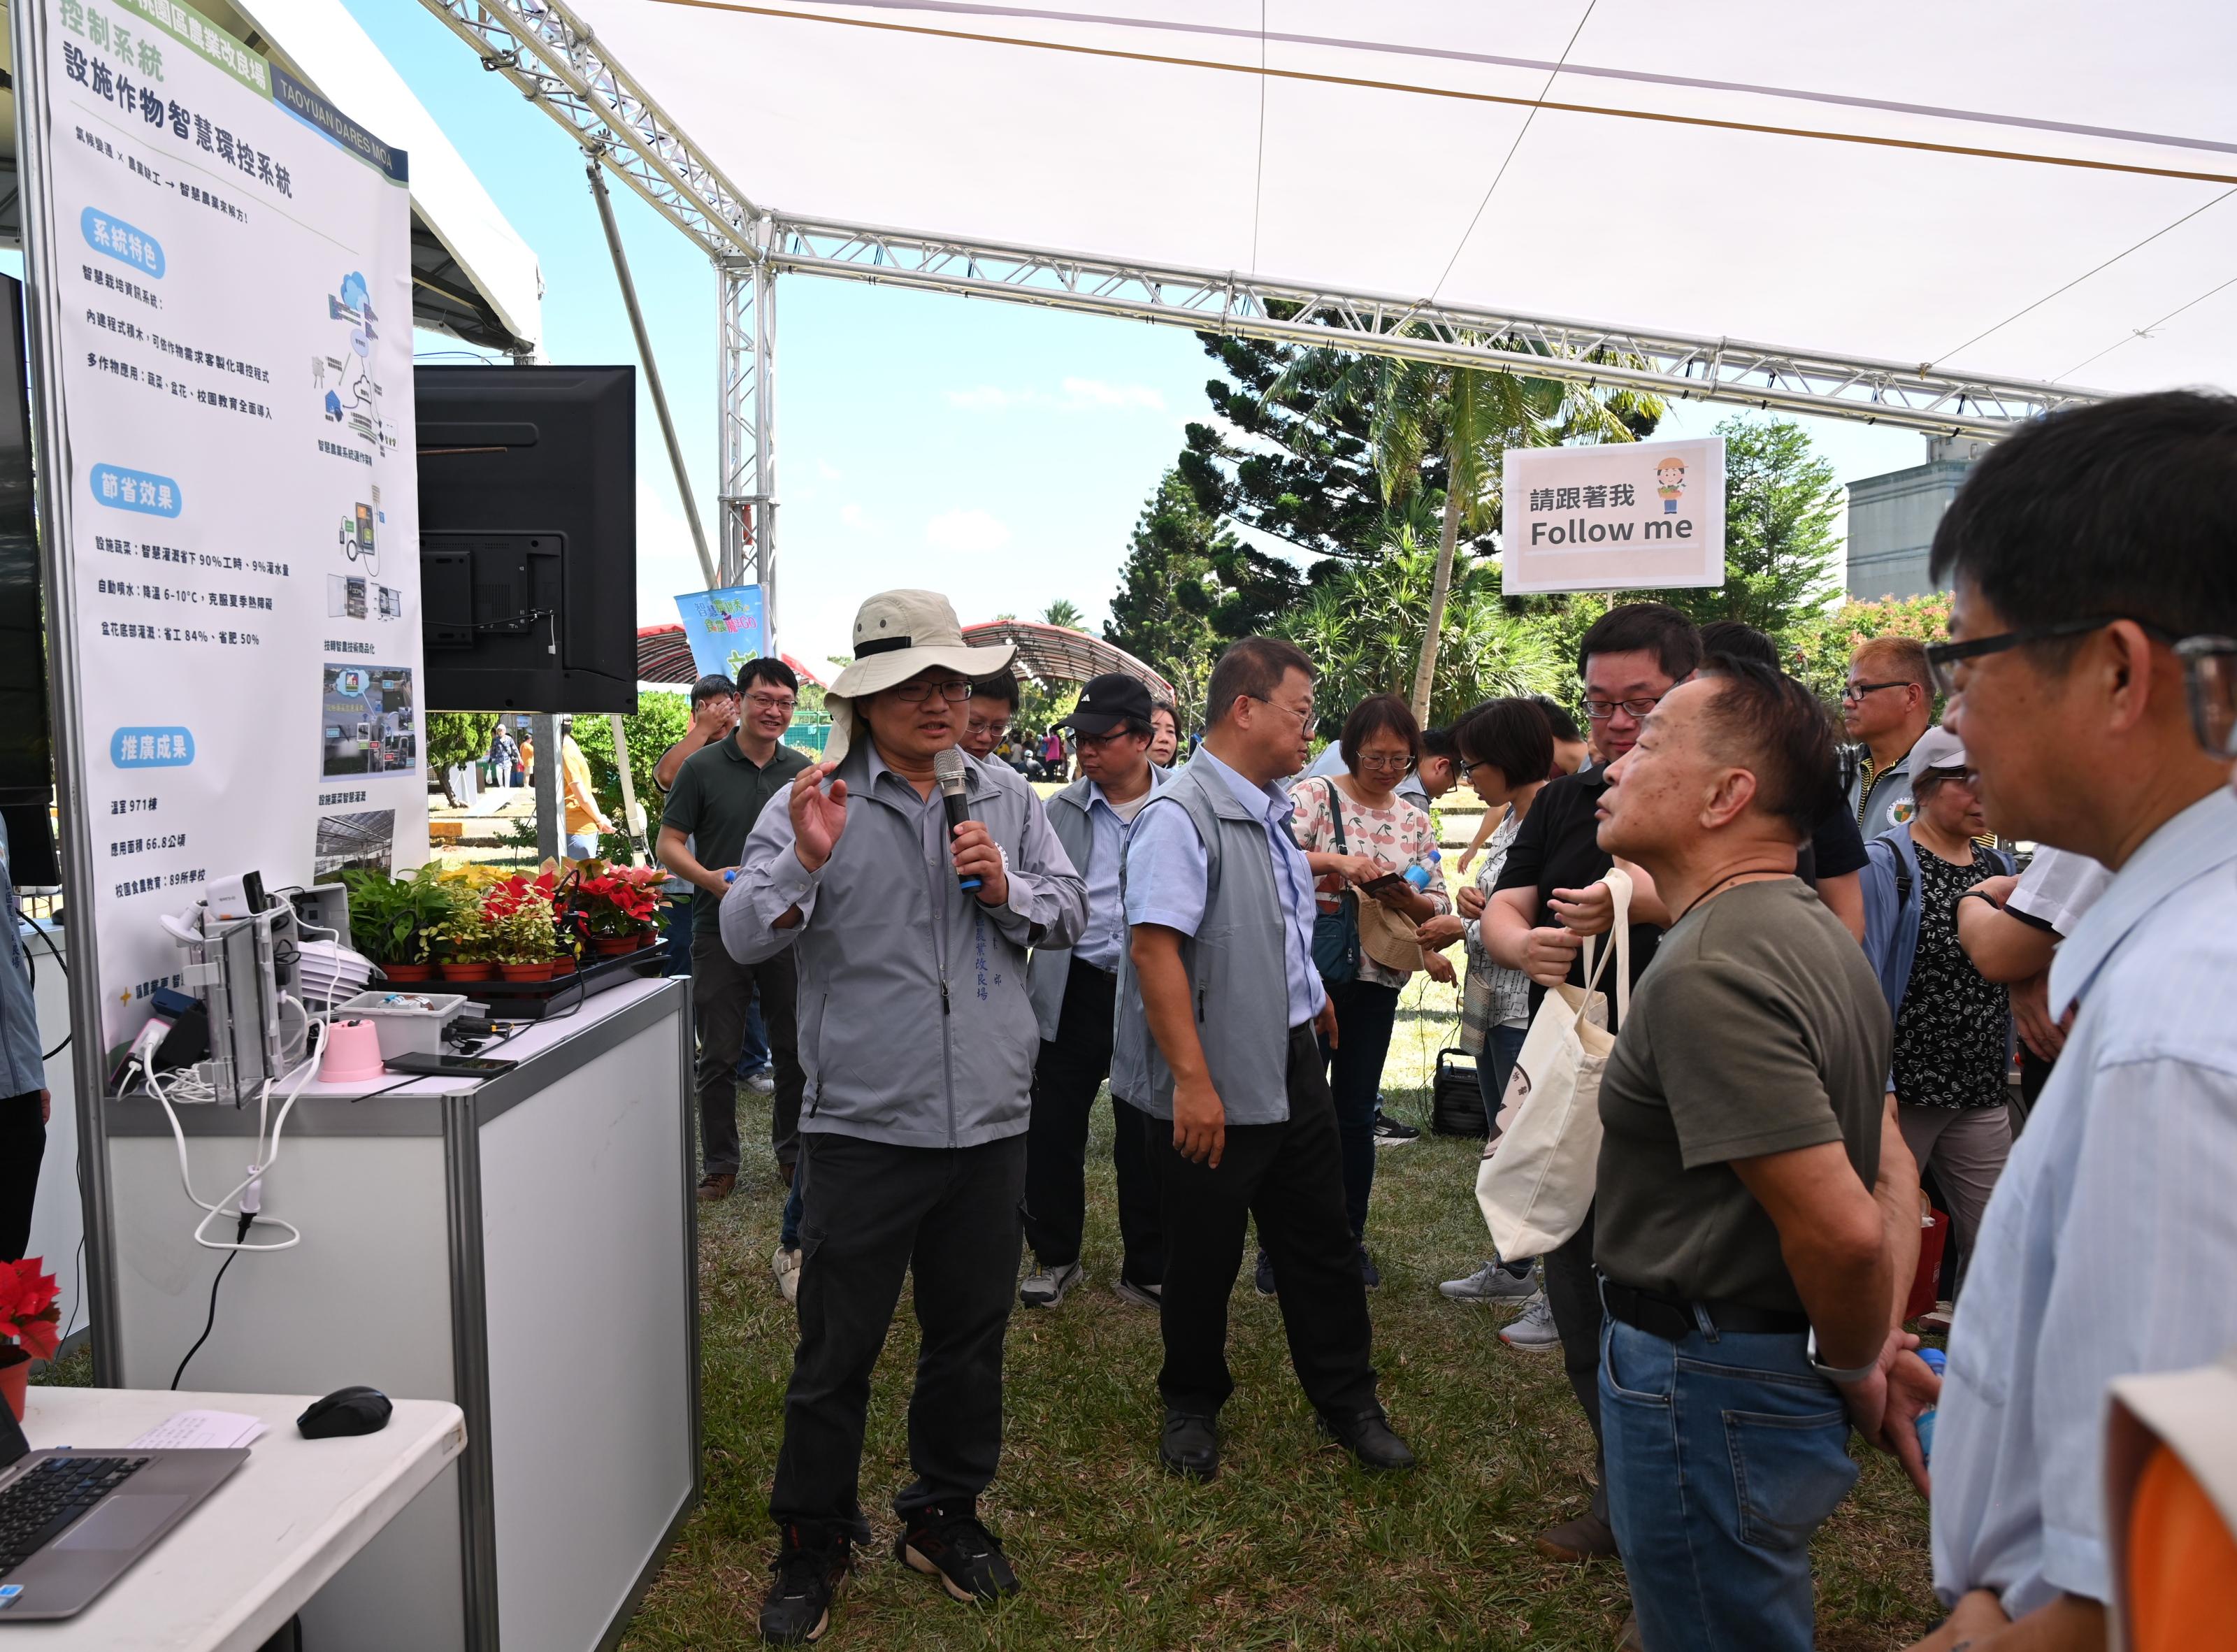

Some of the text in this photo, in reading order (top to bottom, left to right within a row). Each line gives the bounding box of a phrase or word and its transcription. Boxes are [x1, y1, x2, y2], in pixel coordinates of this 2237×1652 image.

[127, 0, 266, 90] 桃園區農業改良場
[63, 40, 293, 199] 設施作物智慧環控系統
[280, 79, 393, 171] TAOYUAN DARES MOA
[93, 217, 157, 271] 系統特色
[101, 471, 173, 510] 節省效果
[1530, 483, 1635, 512] 請跟著我
[1531, 519, 1692, 546] Follow me
[121, 733, 187, 761] 推廣成果
